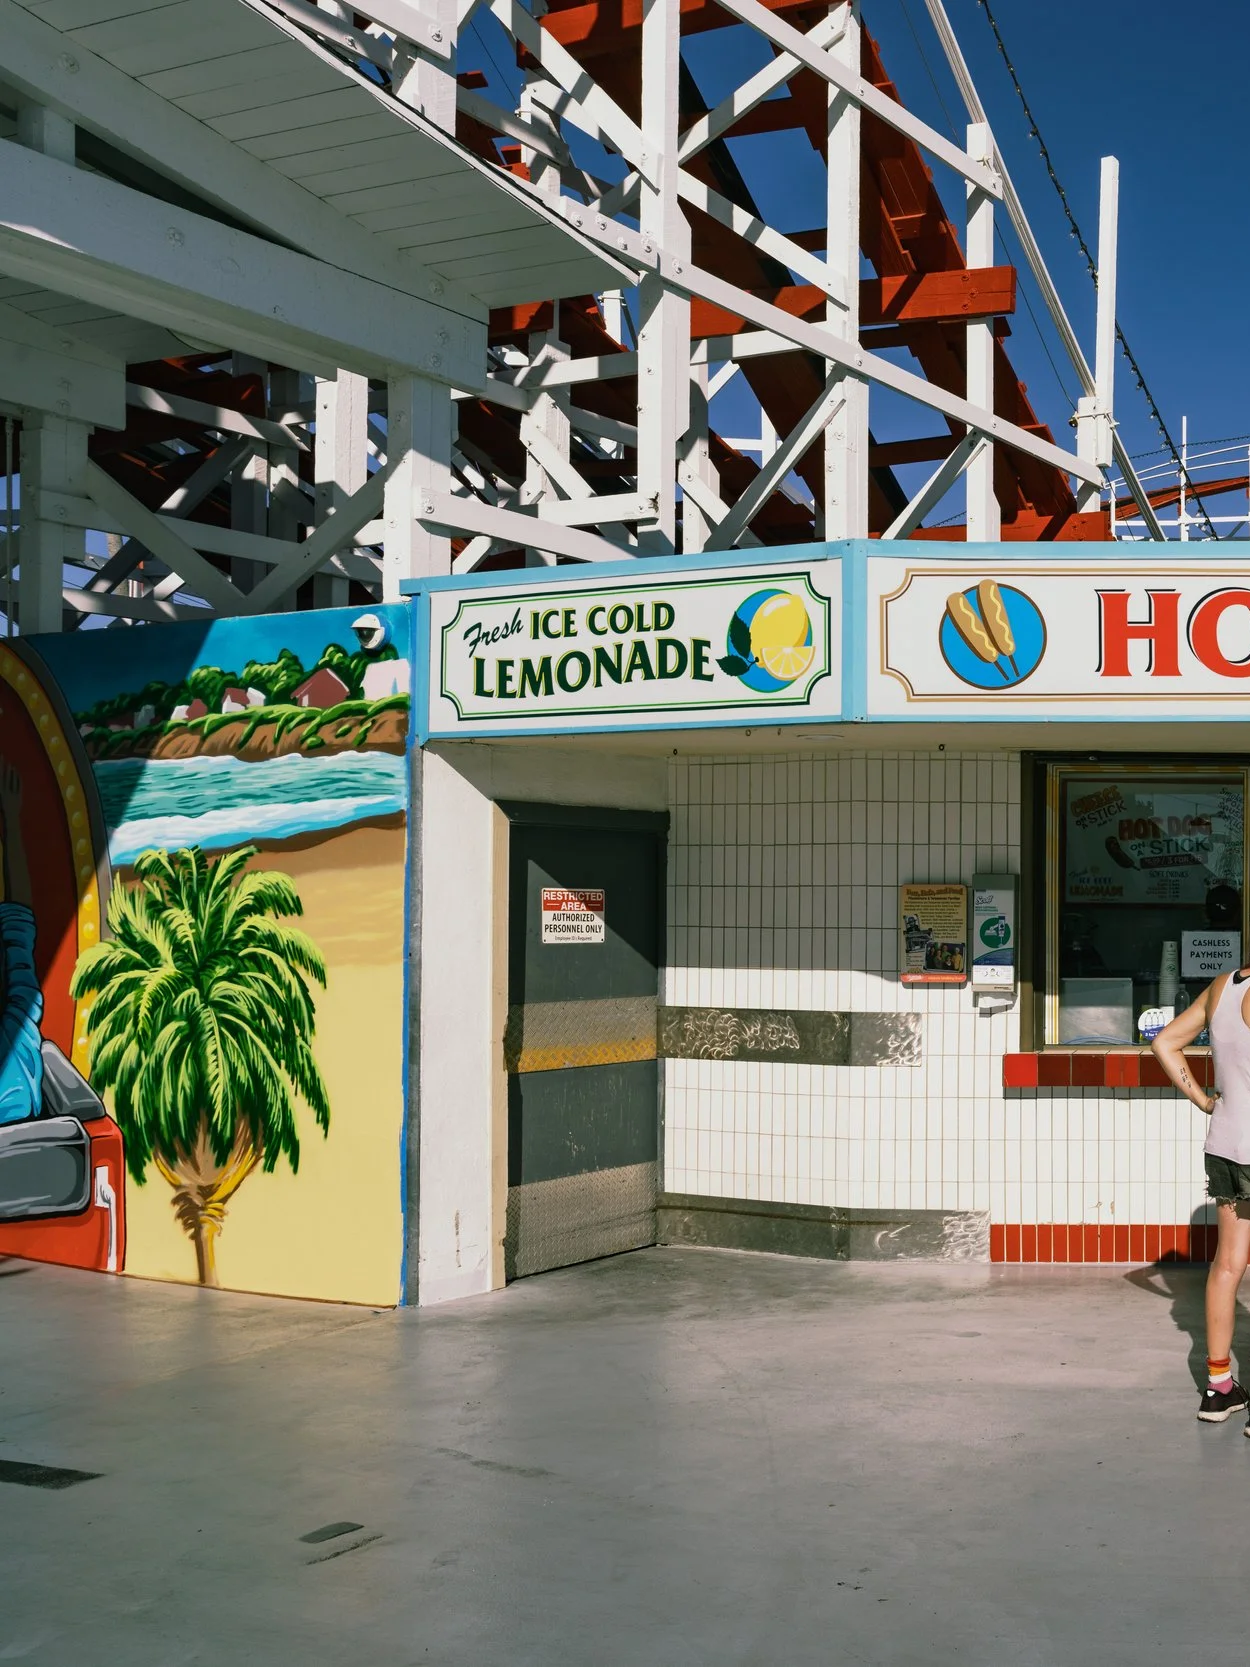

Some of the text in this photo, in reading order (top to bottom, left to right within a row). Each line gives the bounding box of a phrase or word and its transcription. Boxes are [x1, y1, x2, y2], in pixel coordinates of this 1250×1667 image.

[463, 600, 675, 658] Fresh ICE COLD
[473, 636, 715, 699] LEMONADE
[1087, 800, 1127, 824] STICK
[1119, 818, 1161, 841] HOT
[1167, 814, 1212, 836] DOG
[1150, 837, 1209, 854] STICK
[543, 891, 603, 901] RESTRICTED
[560, 902, 587, 911] AREA
[552, 913, 595, 922] AUTHORIZED
[544, 924, 603, 933] PERSONNEL ONLY
[1192, 939, 1231, 947] CASHLESS
